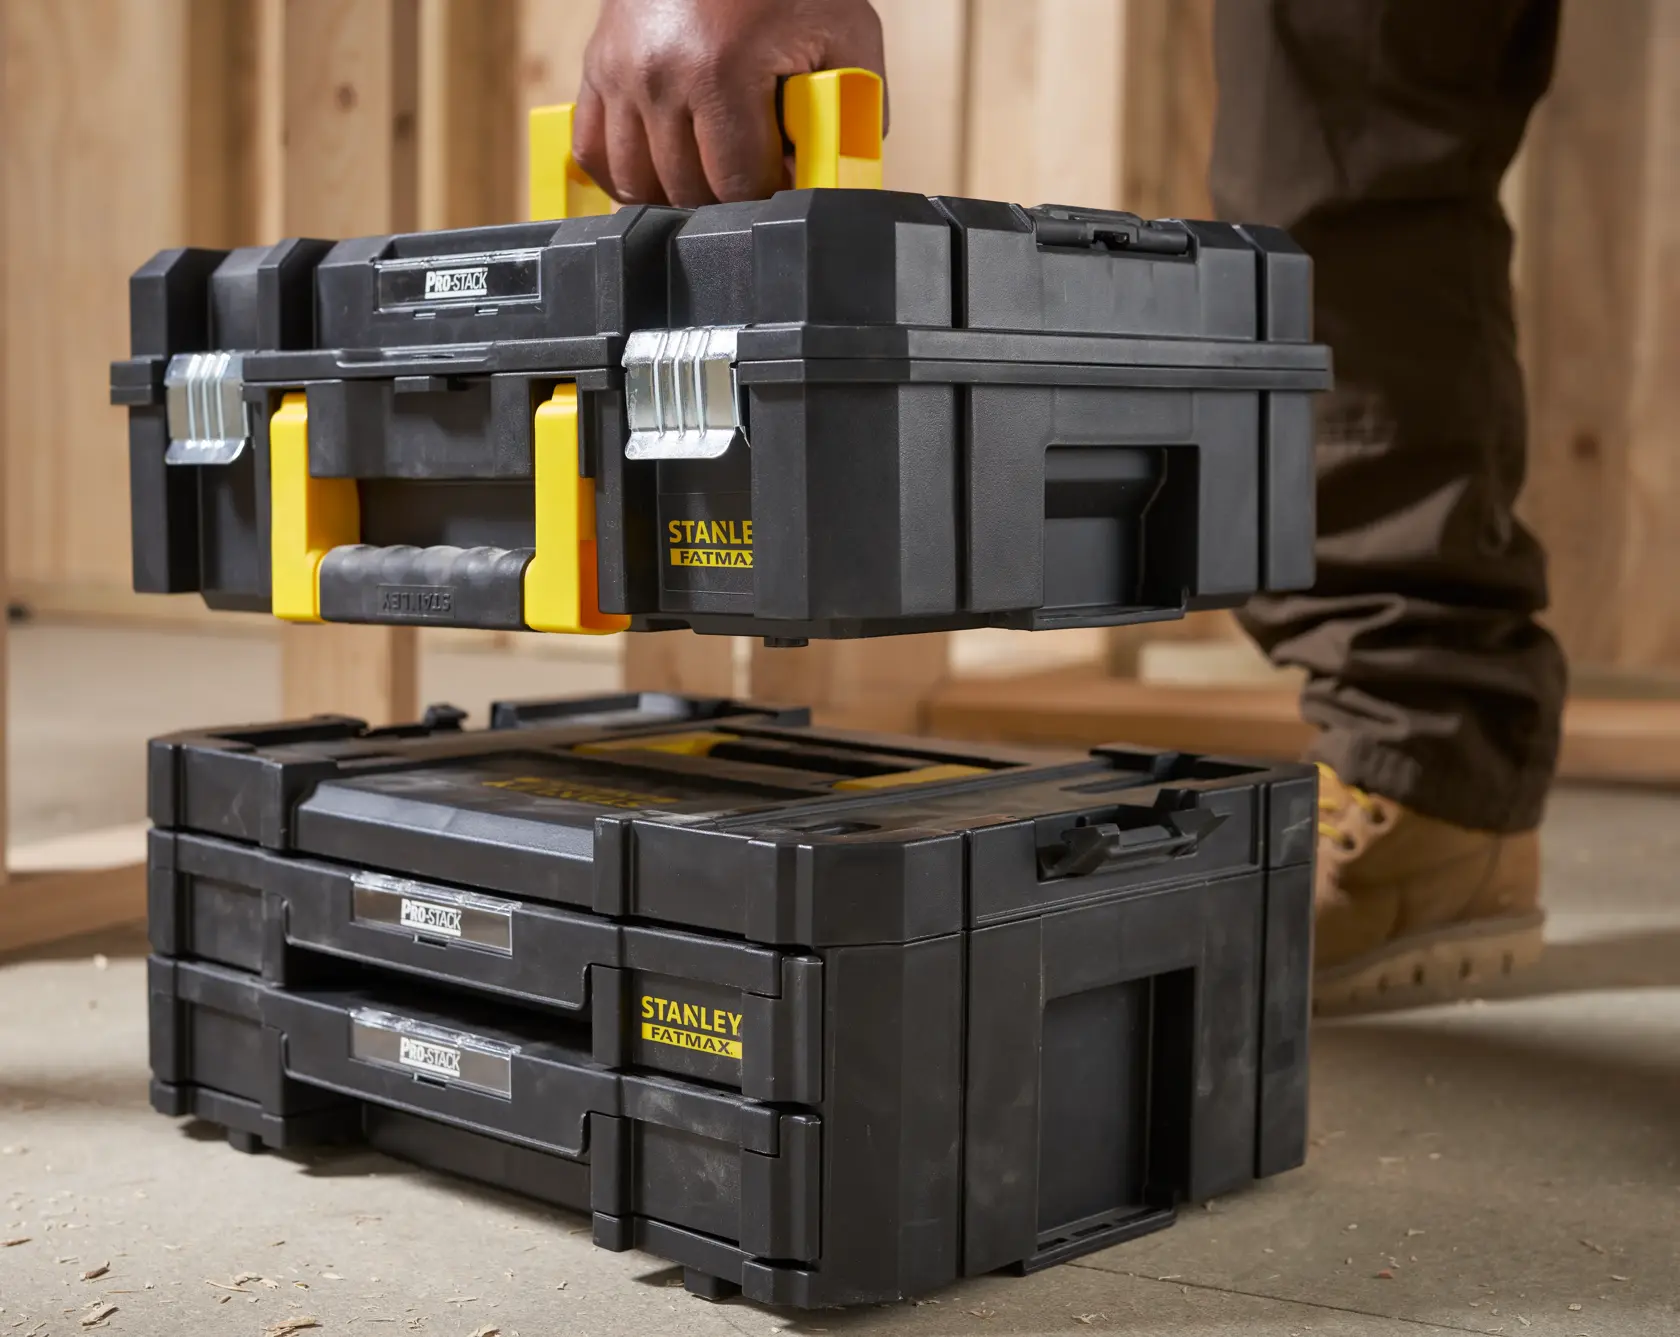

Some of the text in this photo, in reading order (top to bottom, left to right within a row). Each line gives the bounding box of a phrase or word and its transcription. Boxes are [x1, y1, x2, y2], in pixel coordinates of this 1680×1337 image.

[425, 270, 488, 293] PRO-STACK
[668, 519, 753, 545] STANLE
[401, 898, 462, 930] PRO-STACK
[641, 995, 743, 1036] STANLEY
[400, 1036, 461, 1071] PRO-STACK
